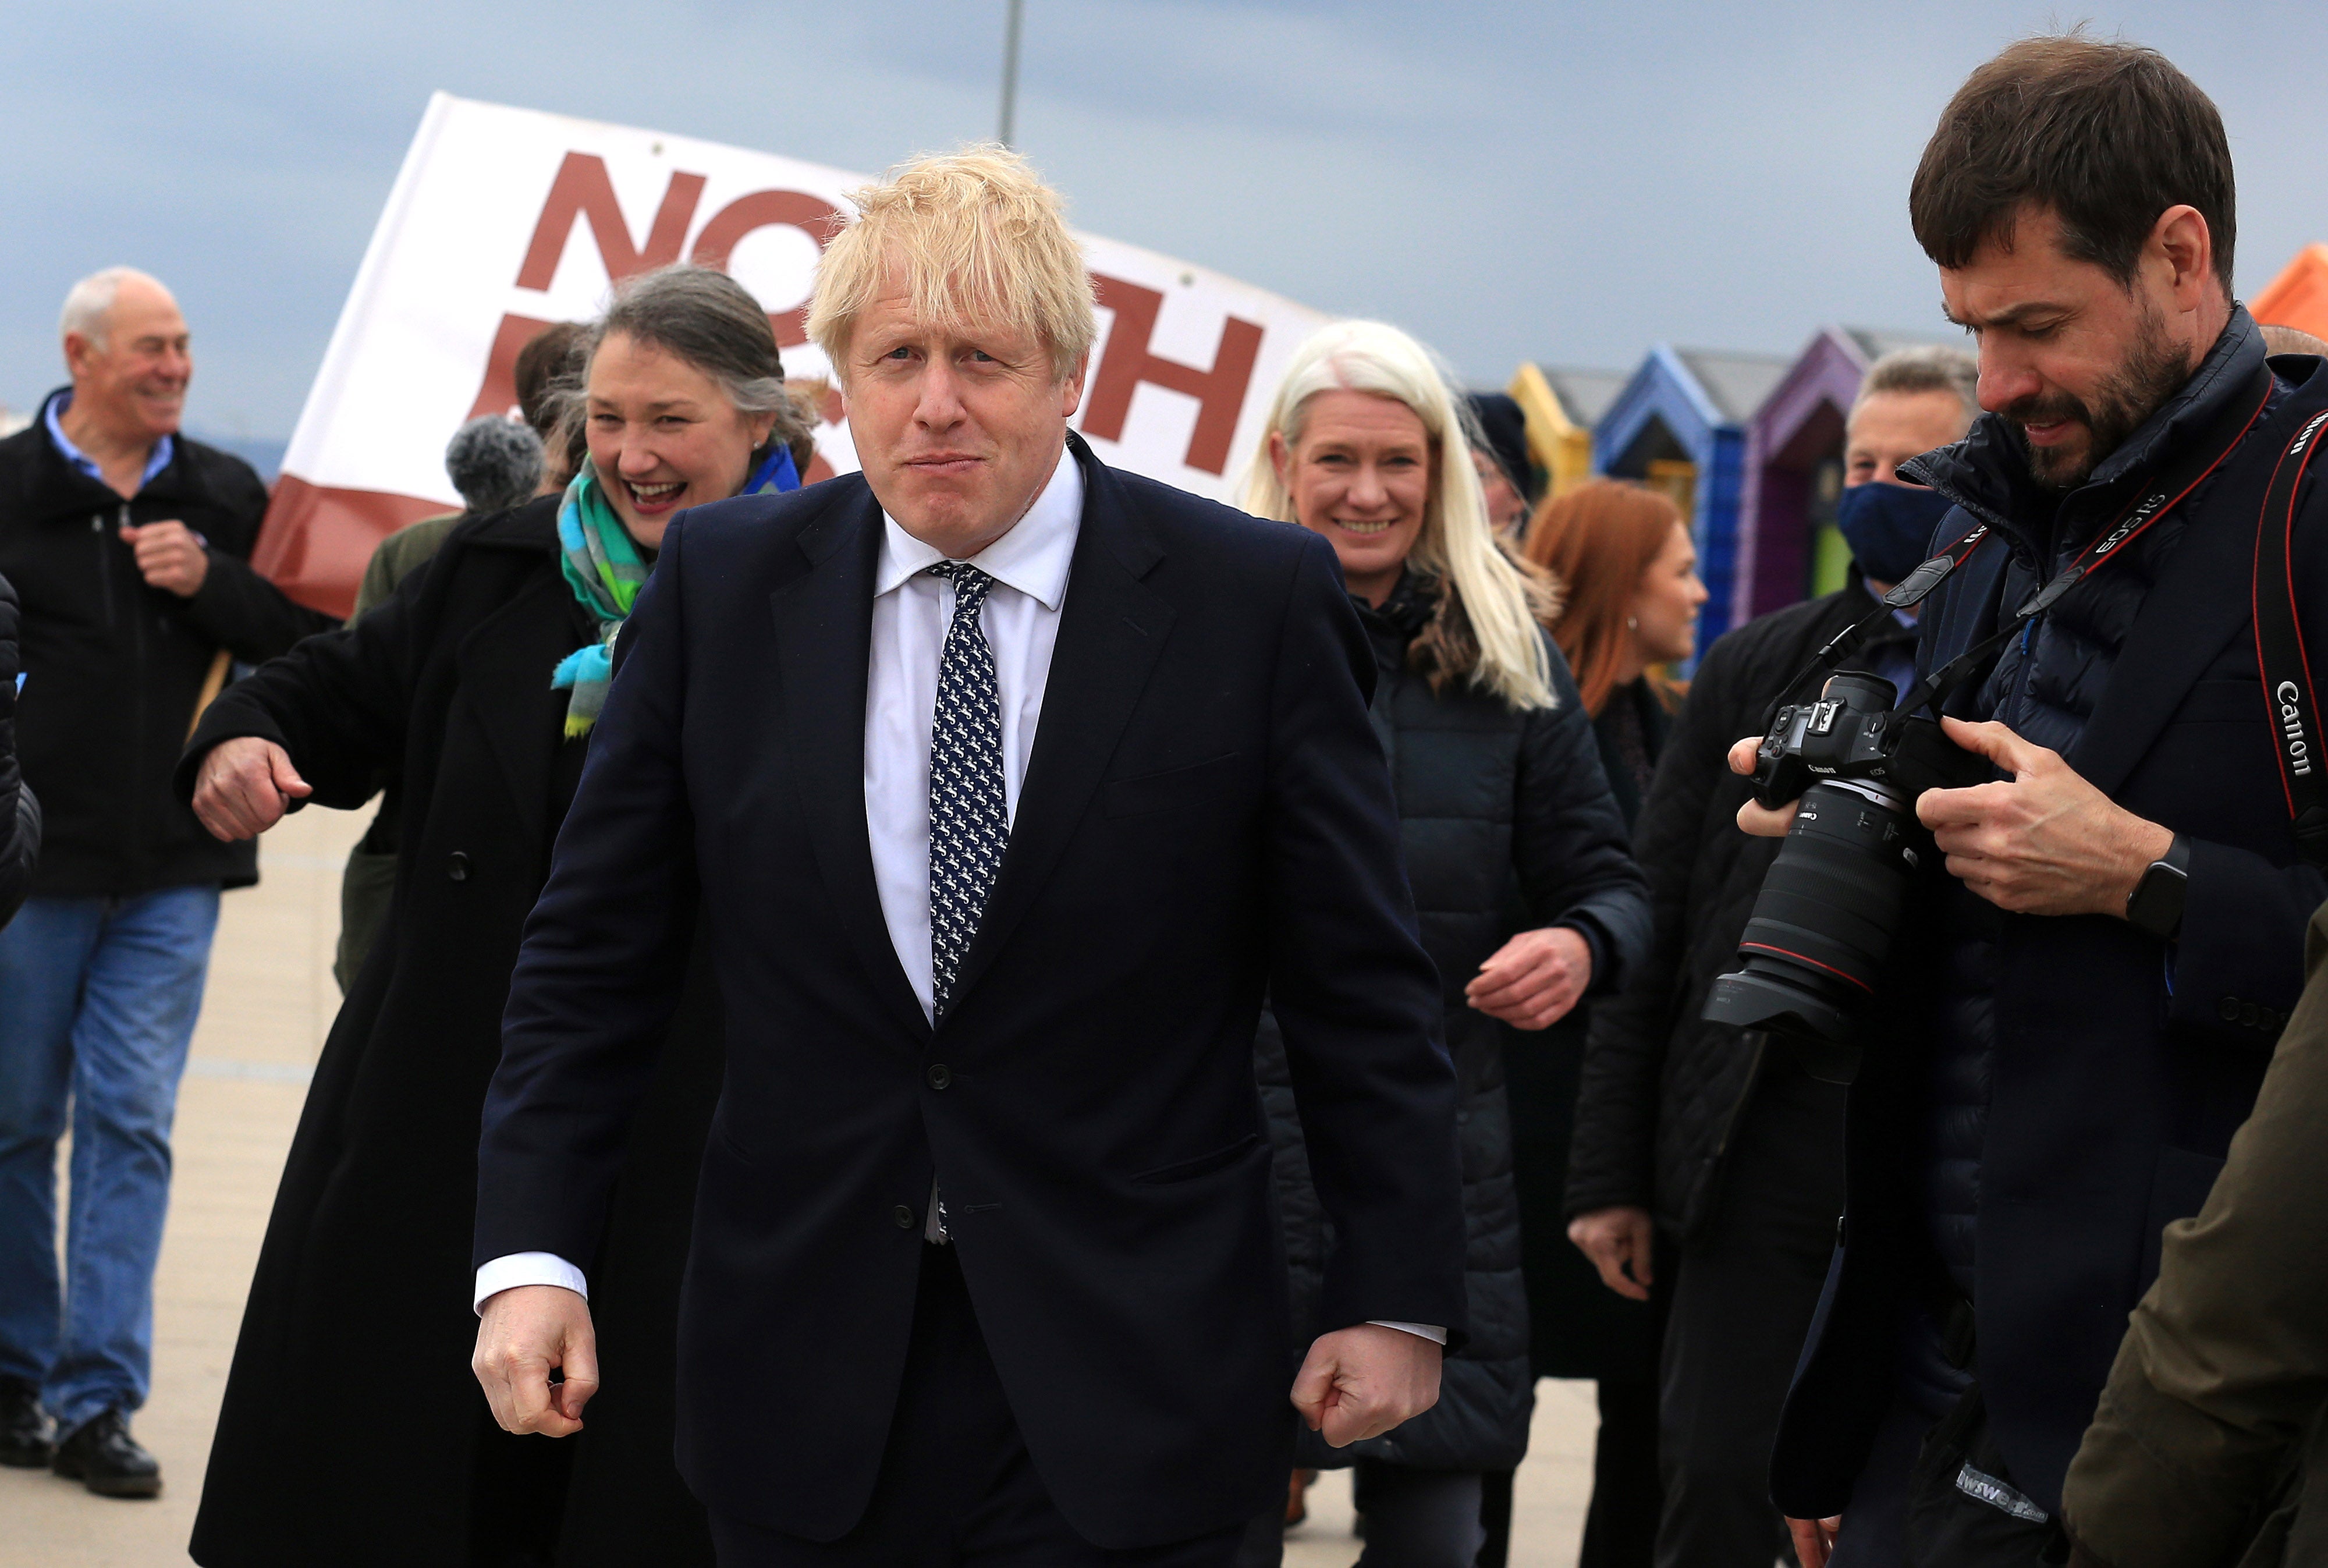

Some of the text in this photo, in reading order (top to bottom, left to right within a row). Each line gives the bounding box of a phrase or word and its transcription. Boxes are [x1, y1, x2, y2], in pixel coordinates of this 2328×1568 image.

[516, 151, 1266, 477] NOTH
[2095, 494, 2166, 554] EOS R5
[2277, 680, 2311, 777] Canon
[1869, 767, 1886, 776] EOS
